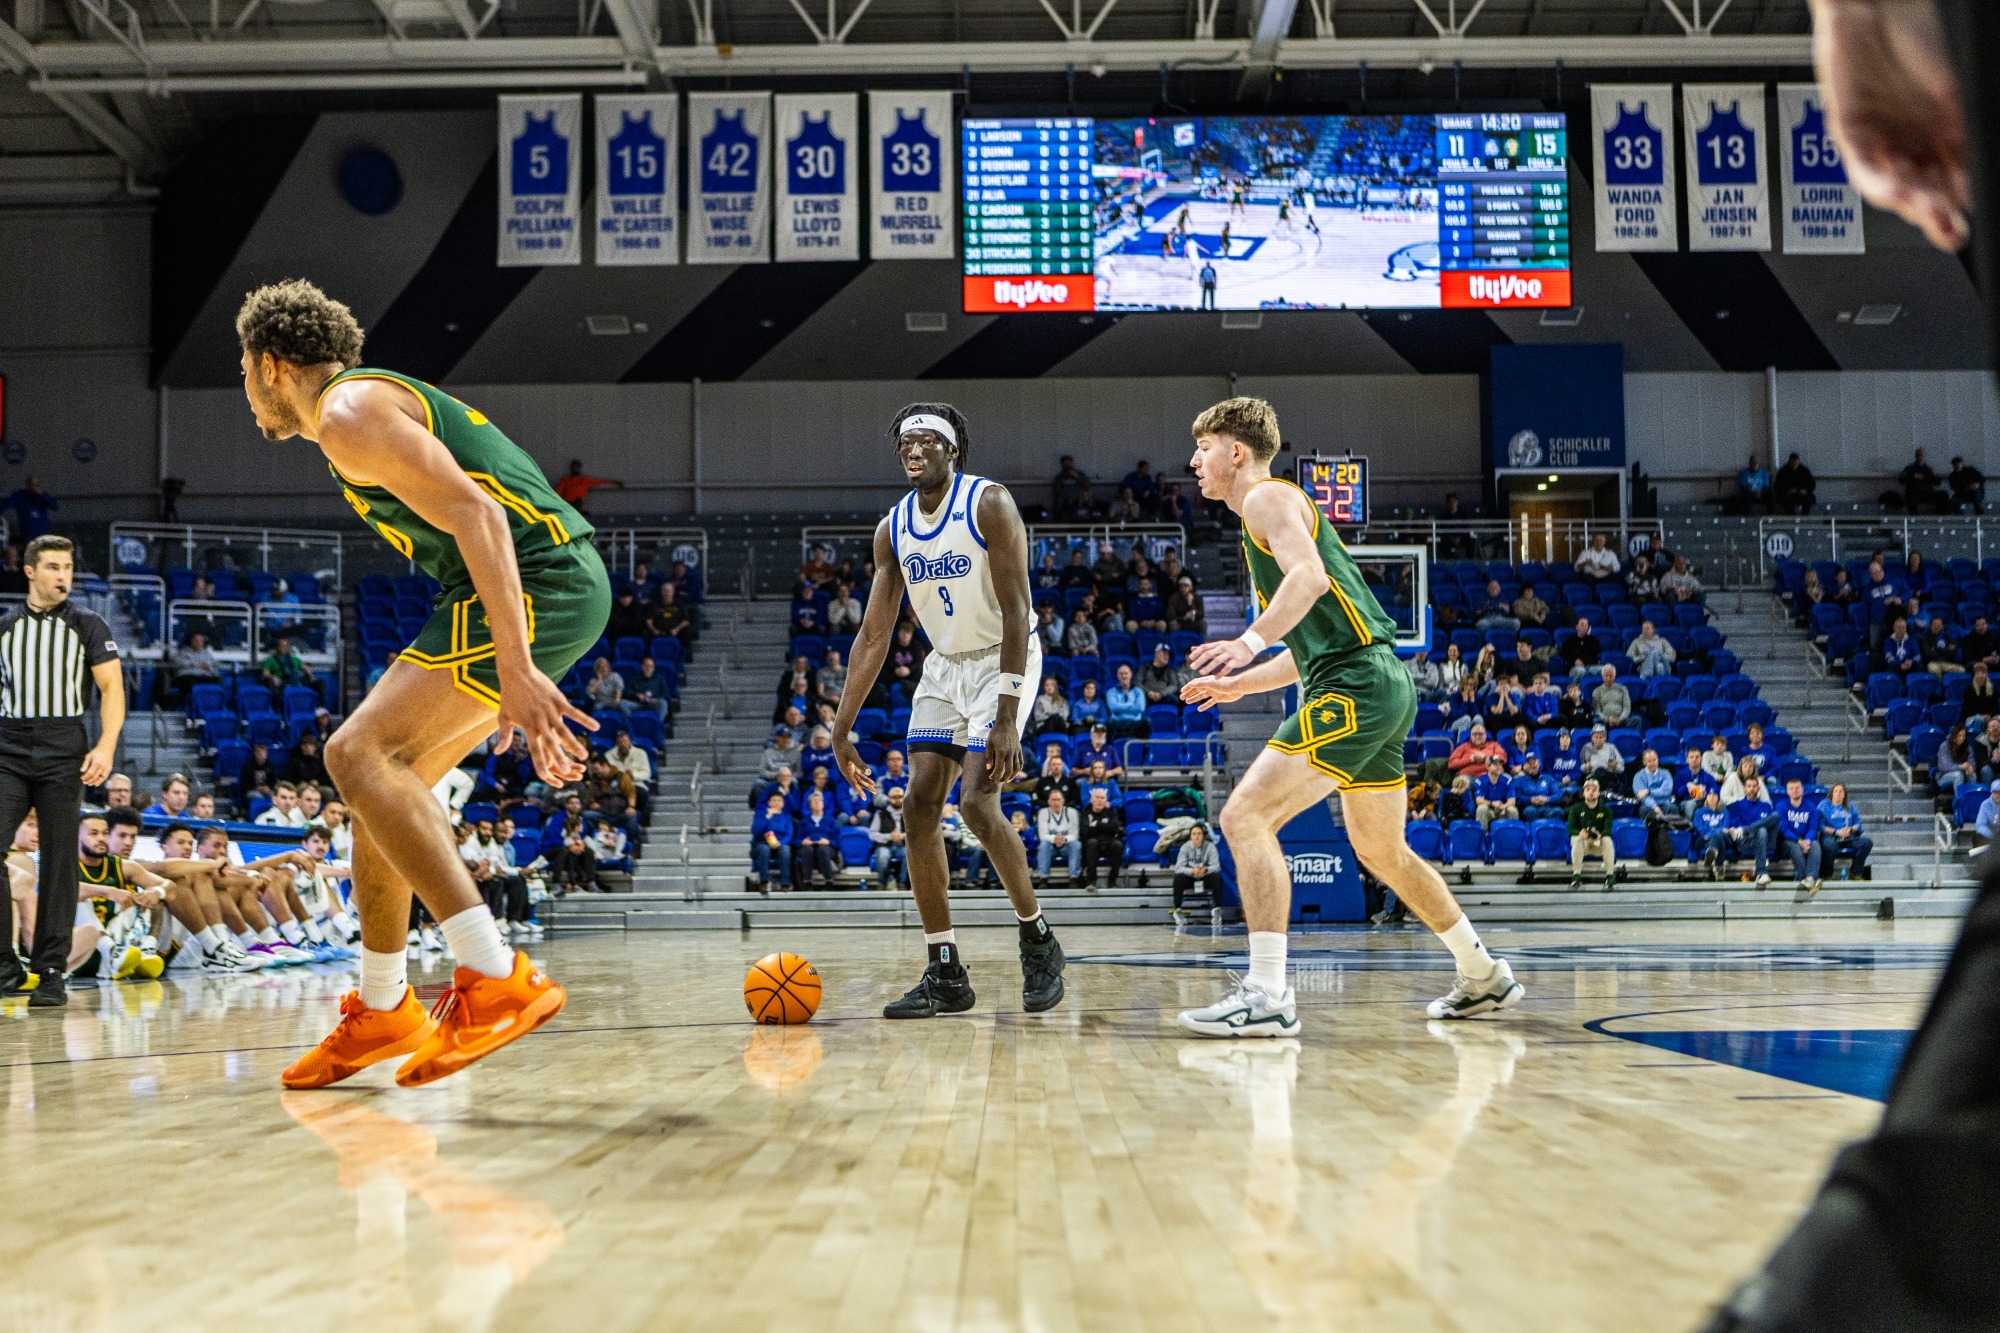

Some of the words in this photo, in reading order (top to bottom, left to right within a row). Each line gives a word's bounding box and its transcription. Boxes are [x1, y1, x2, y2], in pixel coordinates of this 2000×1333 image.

[1442, 117, 1473, 130] DRAKE
[1481, 114, 1522, 131] 14:20
[969, 131, 976, 142] 1
[981, 131, 1022, 142] LARSON
[1534, 134, 1556, 155] 15
[968, 146, 978, 158] 3
[981, 146, 1014, 158] QUINN
[1448, 135, 1464, 156] 11
[1614, 135, 1652, 170] 33
[1707, 135, 1746, 169] 13
[1801, 134, 1841, 167] 55
[530, 146, 549, 179] 5
[617, 145, 657, 179] 15
[708, 143, 749, 176] 42
[797, 146, 836, 178] 30
[891, 143, 932, 176] 33
[1608, 189, 1662, 204] WANDA
[1713, 189, 1744, 204] JAN
[1801, 188, 1843, 201] LORRI
[703, 198, 753, 211] WILLIE
[793, 200, 839, 214] LEWIS
[895, 198, 928, 211] RED
[982, 204, 1024, 216] CARSON
[881, 215, 942, 230] MURRELL
[1615, 208, 1655, 223] FORD
[1702, 208, 1757, 223] JENSEN
[1792, 207, 1854, 223] BAUMAN
[710, 216, 746, 231] WISE
[793, 217, 841, 232] LLOYD
[1487, 230, 1521, 240] REBOUNDS
[994, 280, 1069, 308] HyVee
[1469, 275, 1542, 304] HyVee
[1548, 437, 1610, 452] SCHICKLER
[1550, 451, 1578, 466] CLUB
[1312, 464, 1360, 484] 14:20
[1314, 485, 1354, 519] 22
[903, 550, 971, 584] Drake
[938, 586, 954, 616] 8
[1284, 853, 1343, 873] Smart
[1294, 873, 1334, 884] Honda
